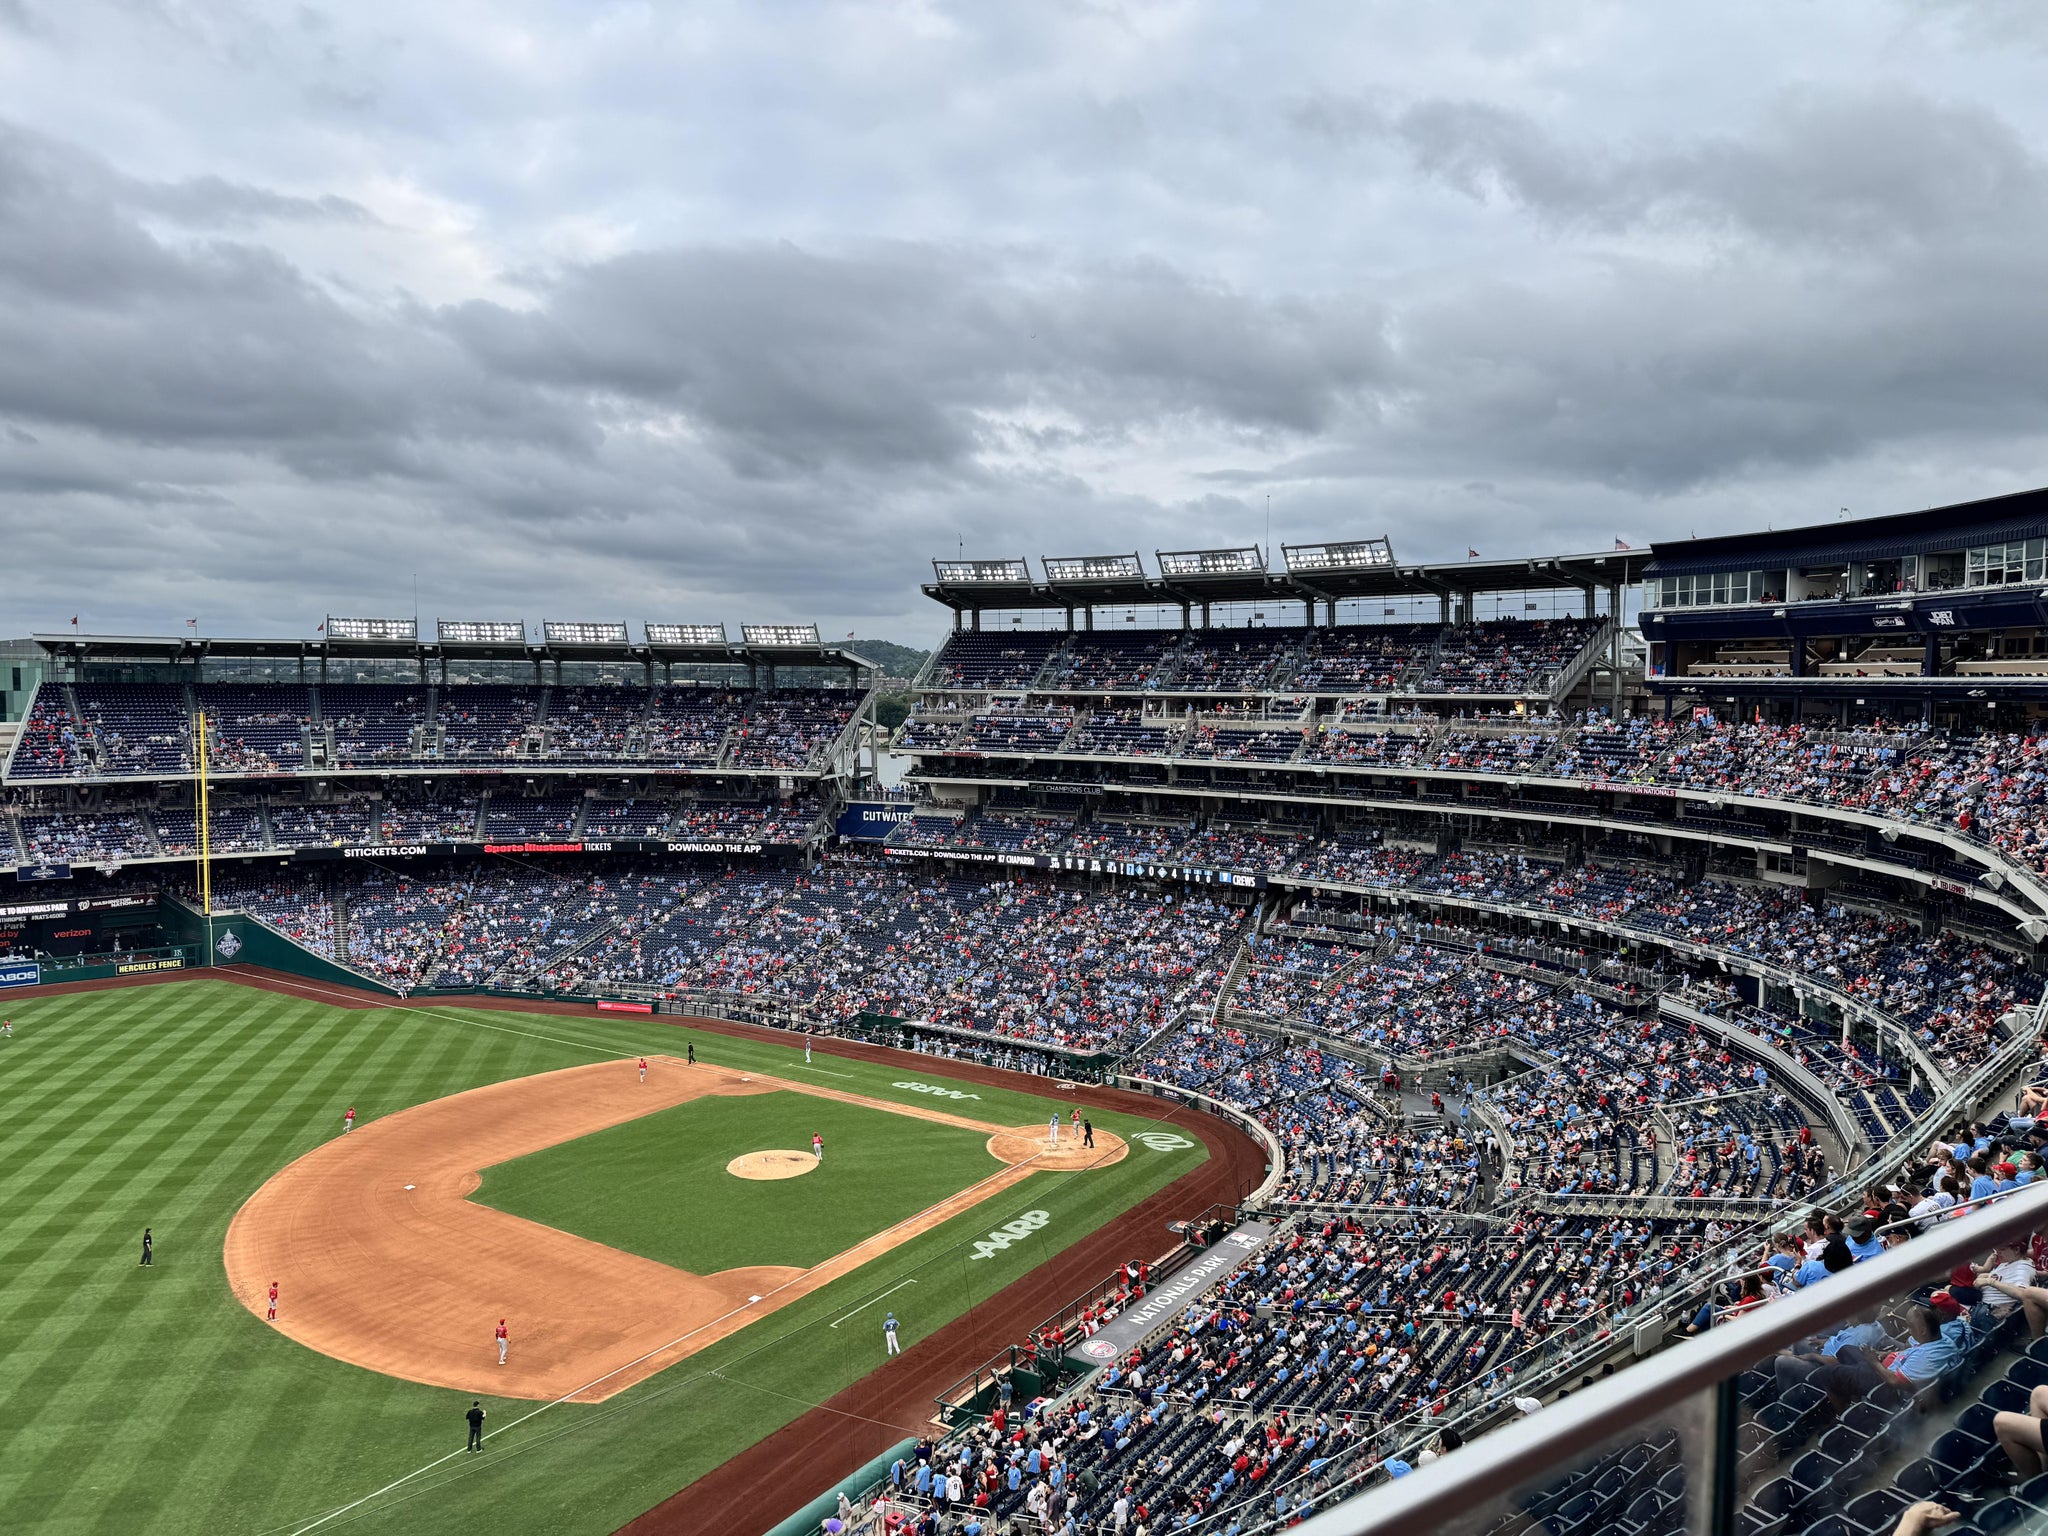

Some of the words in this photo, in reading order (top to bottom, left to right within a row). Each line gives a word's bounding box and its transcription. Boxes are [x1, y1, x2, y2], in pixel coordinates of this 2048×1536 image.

[1045, 785, 1083, 794] CHAMPIONS
[1607, 785, 1642, 794] WASHINGTON
[1643, 787, 1675, 797] NATIONALS
[344, 846, 427, 857] SITICKETS.COM
[484, 844, 524, 853] Sports
[584, 843, 612, 852] TICKETS
[667, 843, 724, 852] DOWNLOAD
[725, 844, 742, 853] THE
[743, 844, 762, 854] APP
[884, 849, 929, 858] SITICKETS.COM
[933, 851, 971, 860] DOWNLOAD
[970, 853, 983, 861] THE
[983, 854, 996, 862] APP
[1006, 855, 1036, 866] CHAPARRO
[1232, 875, 1256, 888] CREWS
[1940, 881, 1949, 890] TED
[91, 897, 132, 907] WASHINGTON
[111, 898, 145, 908] NATIONALS
[1422, 896, 1443, 904] GIBSON
[7, 906, 16, 916] TO
[16, 904, 51, 915] NATIONALS
[51, 902, 69, 912] PARK
[1508, 909, 1527, 917] POSEY
[1537, 913, 1560, 922] WILSON
[4, 921, 26, 930] Park
[8, 930, 19, 939] by
[53, 928, 92, 939] verizon
[1634, 932, 1655, 943] GOSLIN
[119, 962, 157, 974] HERCULES
[158, 959, 182, 970] FENCE
[891, 1081, 982, 1100] AARP
[969, 1209, 1050, 1261] AARP
[1239, 1235, 1263, 1251] MLB
[1128, 1275, 1200, 1327] NATIONALS
[1191, 1254, 1228, 1279] PARK
